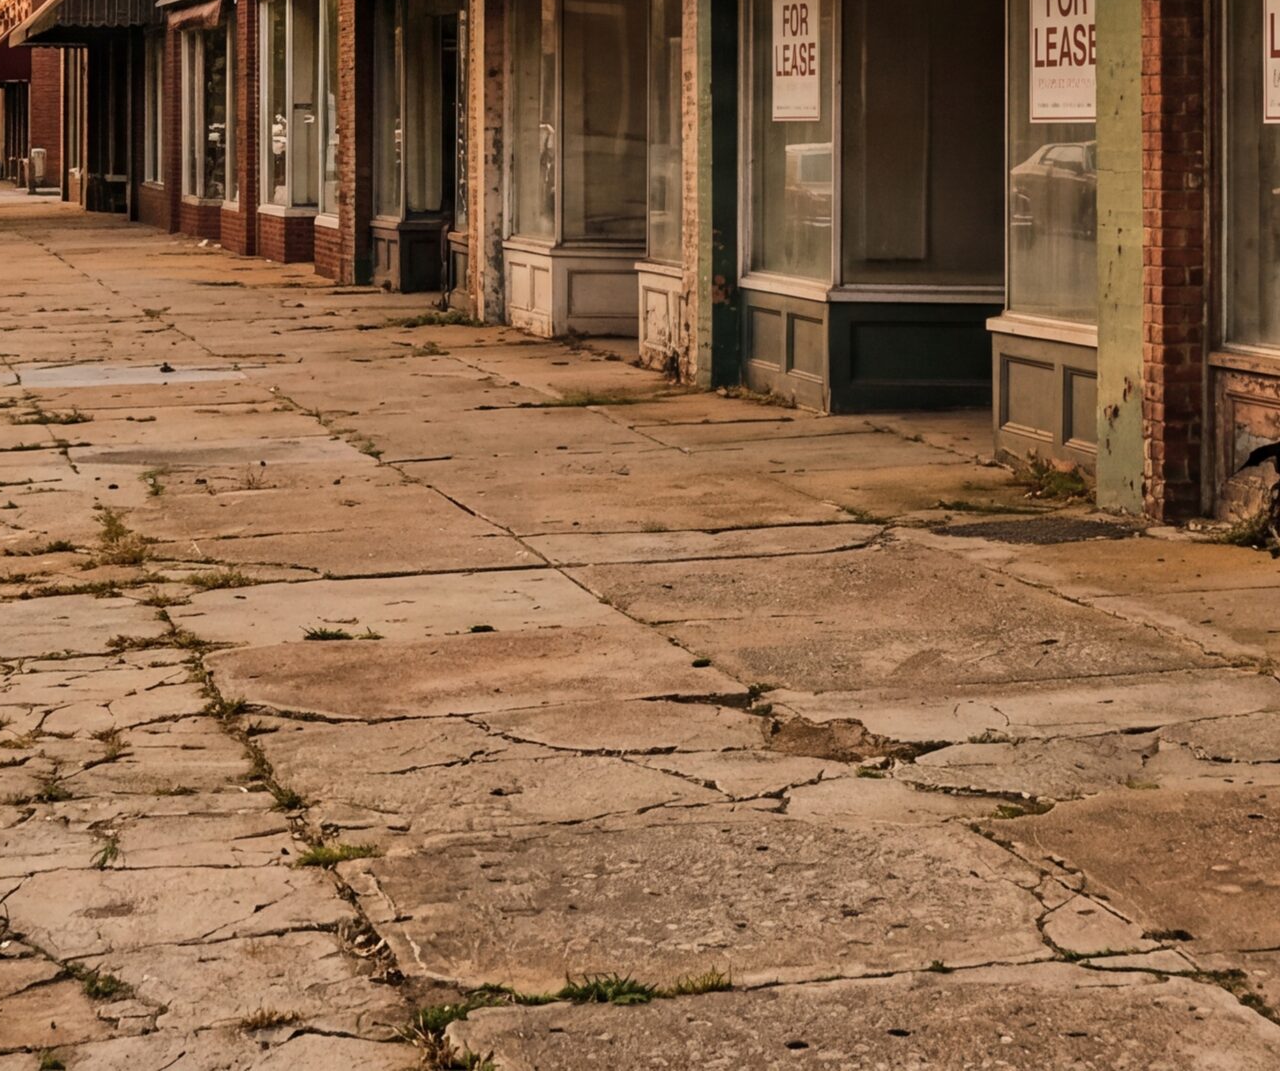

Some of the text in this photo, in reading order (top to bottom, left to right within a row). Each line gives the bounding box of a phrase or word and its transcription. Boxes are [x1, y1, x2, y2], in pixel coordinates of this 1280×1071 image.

[783, 3, 808, 37] FOR
[775, 42, 816, 77] LEASE
[1034, 24, 1096, 68] LEASE
